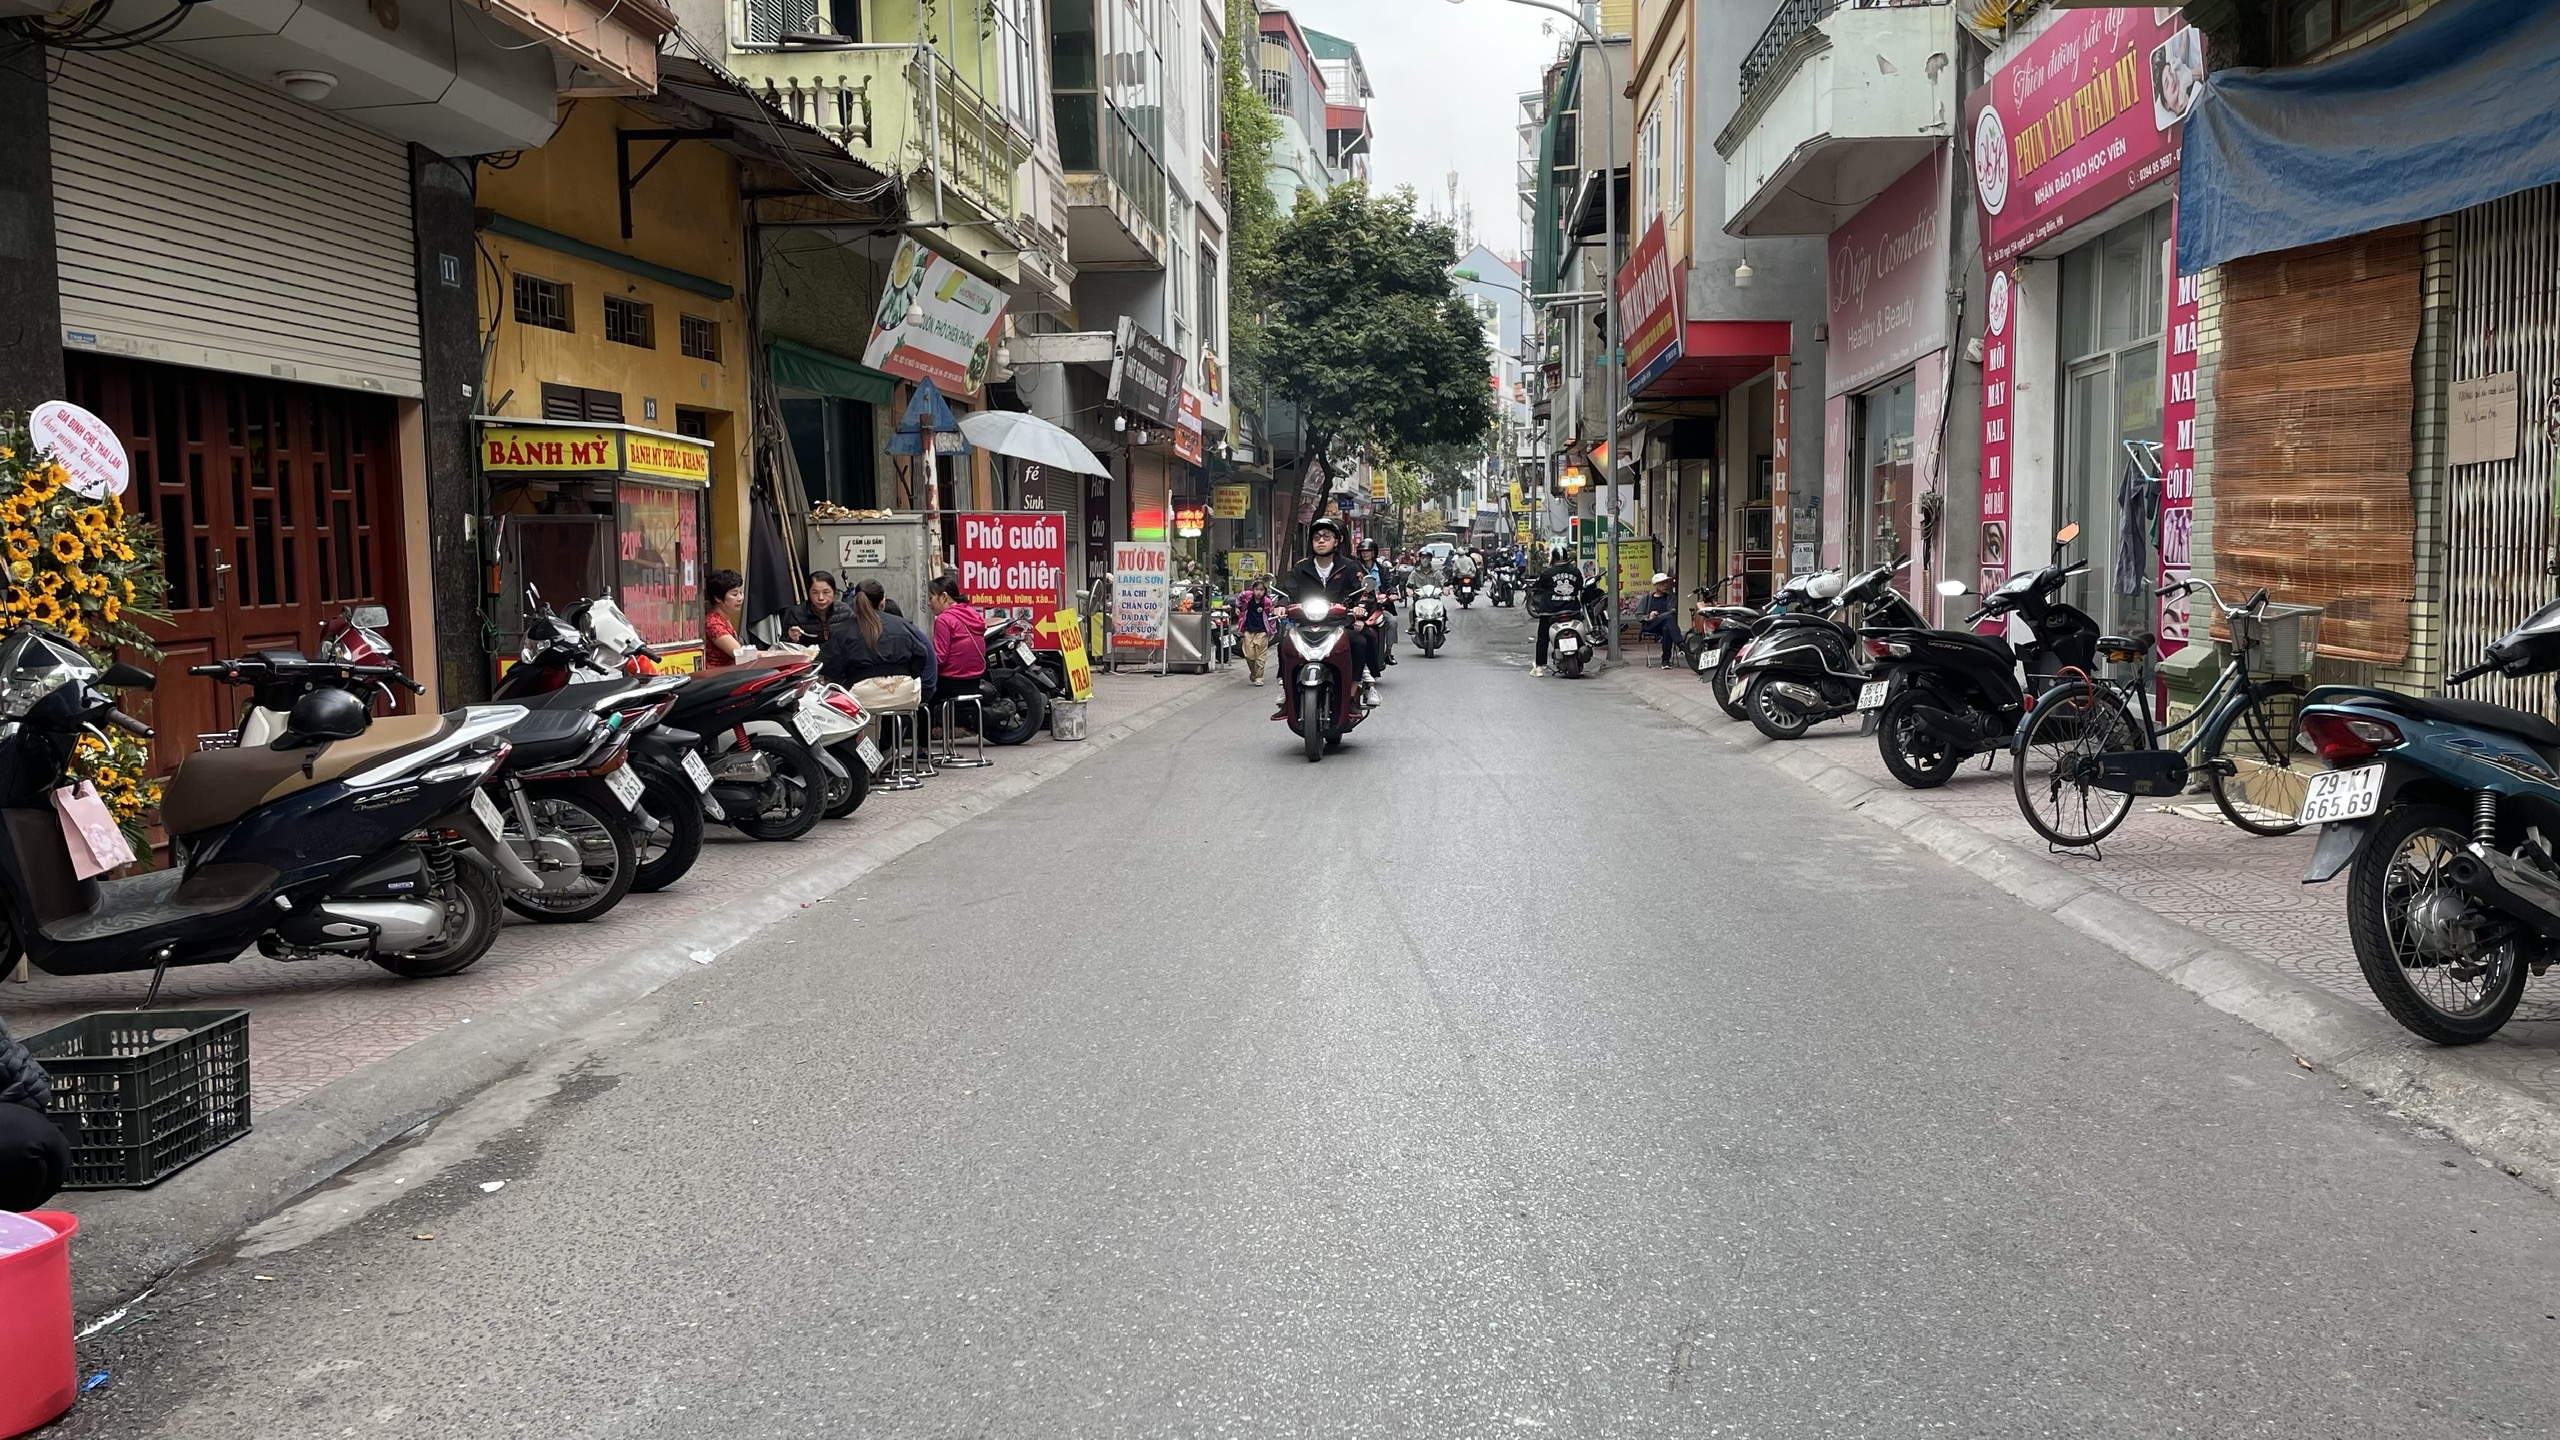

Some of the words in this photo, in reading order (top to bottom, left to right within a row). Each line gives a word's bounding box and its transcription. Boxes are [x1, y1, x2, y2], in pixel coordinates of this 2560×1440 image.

[2047, 35, 2081, 83] đường
[2014, 118, 2047, 181] PHUN
[2046, 97, 2075, 158] XĂM
[2074, 56, 2116, 140] THẨM
[2115, 39, 2140, 113] MỸ
[2034, 184, 2055, 206] NHẬN
[2055, 171, 2071, 193] ĐÀO
[2072, 161, 2087, 185] TẠO
[2088, 150, 2106, 175] HỌC
[2107, 137, 2127, 162] VIÊN
[1877, 205, 1939, 279] Cosmetics
[444, 260, 455, 281] 11
[1847, 316, 1875, 352] Healthy
[1876, 310, 1883, 338] &
[1884, 297, 1914, 332] Beauty
[2174, 315, 2197, 355] MÀ
[1989, 342, 2005, 371] MÔI
[1987, 379, 2005, 408] MÀY
[2171, 369, 2197, 403] NAI
[647, 401, 655, 418] 13
[57, 409, 70, 424] GIA
[108, 454, 122, 470] LAN
[1986, 418, 2005, 444] NAIL
[489, 435, 563, 465] BÁNH
[571, 434, 609, 465] MỲ
[630, 439, 651, 465] BÁNH
[652, 442, 662, 467] MỲ
[663, 444, 681, 469] PHÚC
[682, 450, 705, 472] KHANG
[1024, 465, 1040, 482] fé
[1989, 456, 2000, 479] MI
[2166, 463, 2183, 503] GỘI
[1024, 494, 1044, 510] Sinh
[621, 530, 642, 560] 20K
[965, 517, 1003, 549] Phở
[1009, 516, 1057, 549] cuốn
[1117, 546, 1165, 571] NƯỚNG
[963, 558, 1001, 589] Phở
[1007, 560, 1060, 590] chiên
[1145, 575, 1164, 584] SƠN
[1061, 621, 1082, 652] CHÁO
[1072, 666, 1088, 693] TRAI
[622, 777, 641, 804] 1853
[2316, 768, 2371, 797] 29-K1
[2305, 791, 2372, 821] 665.69
